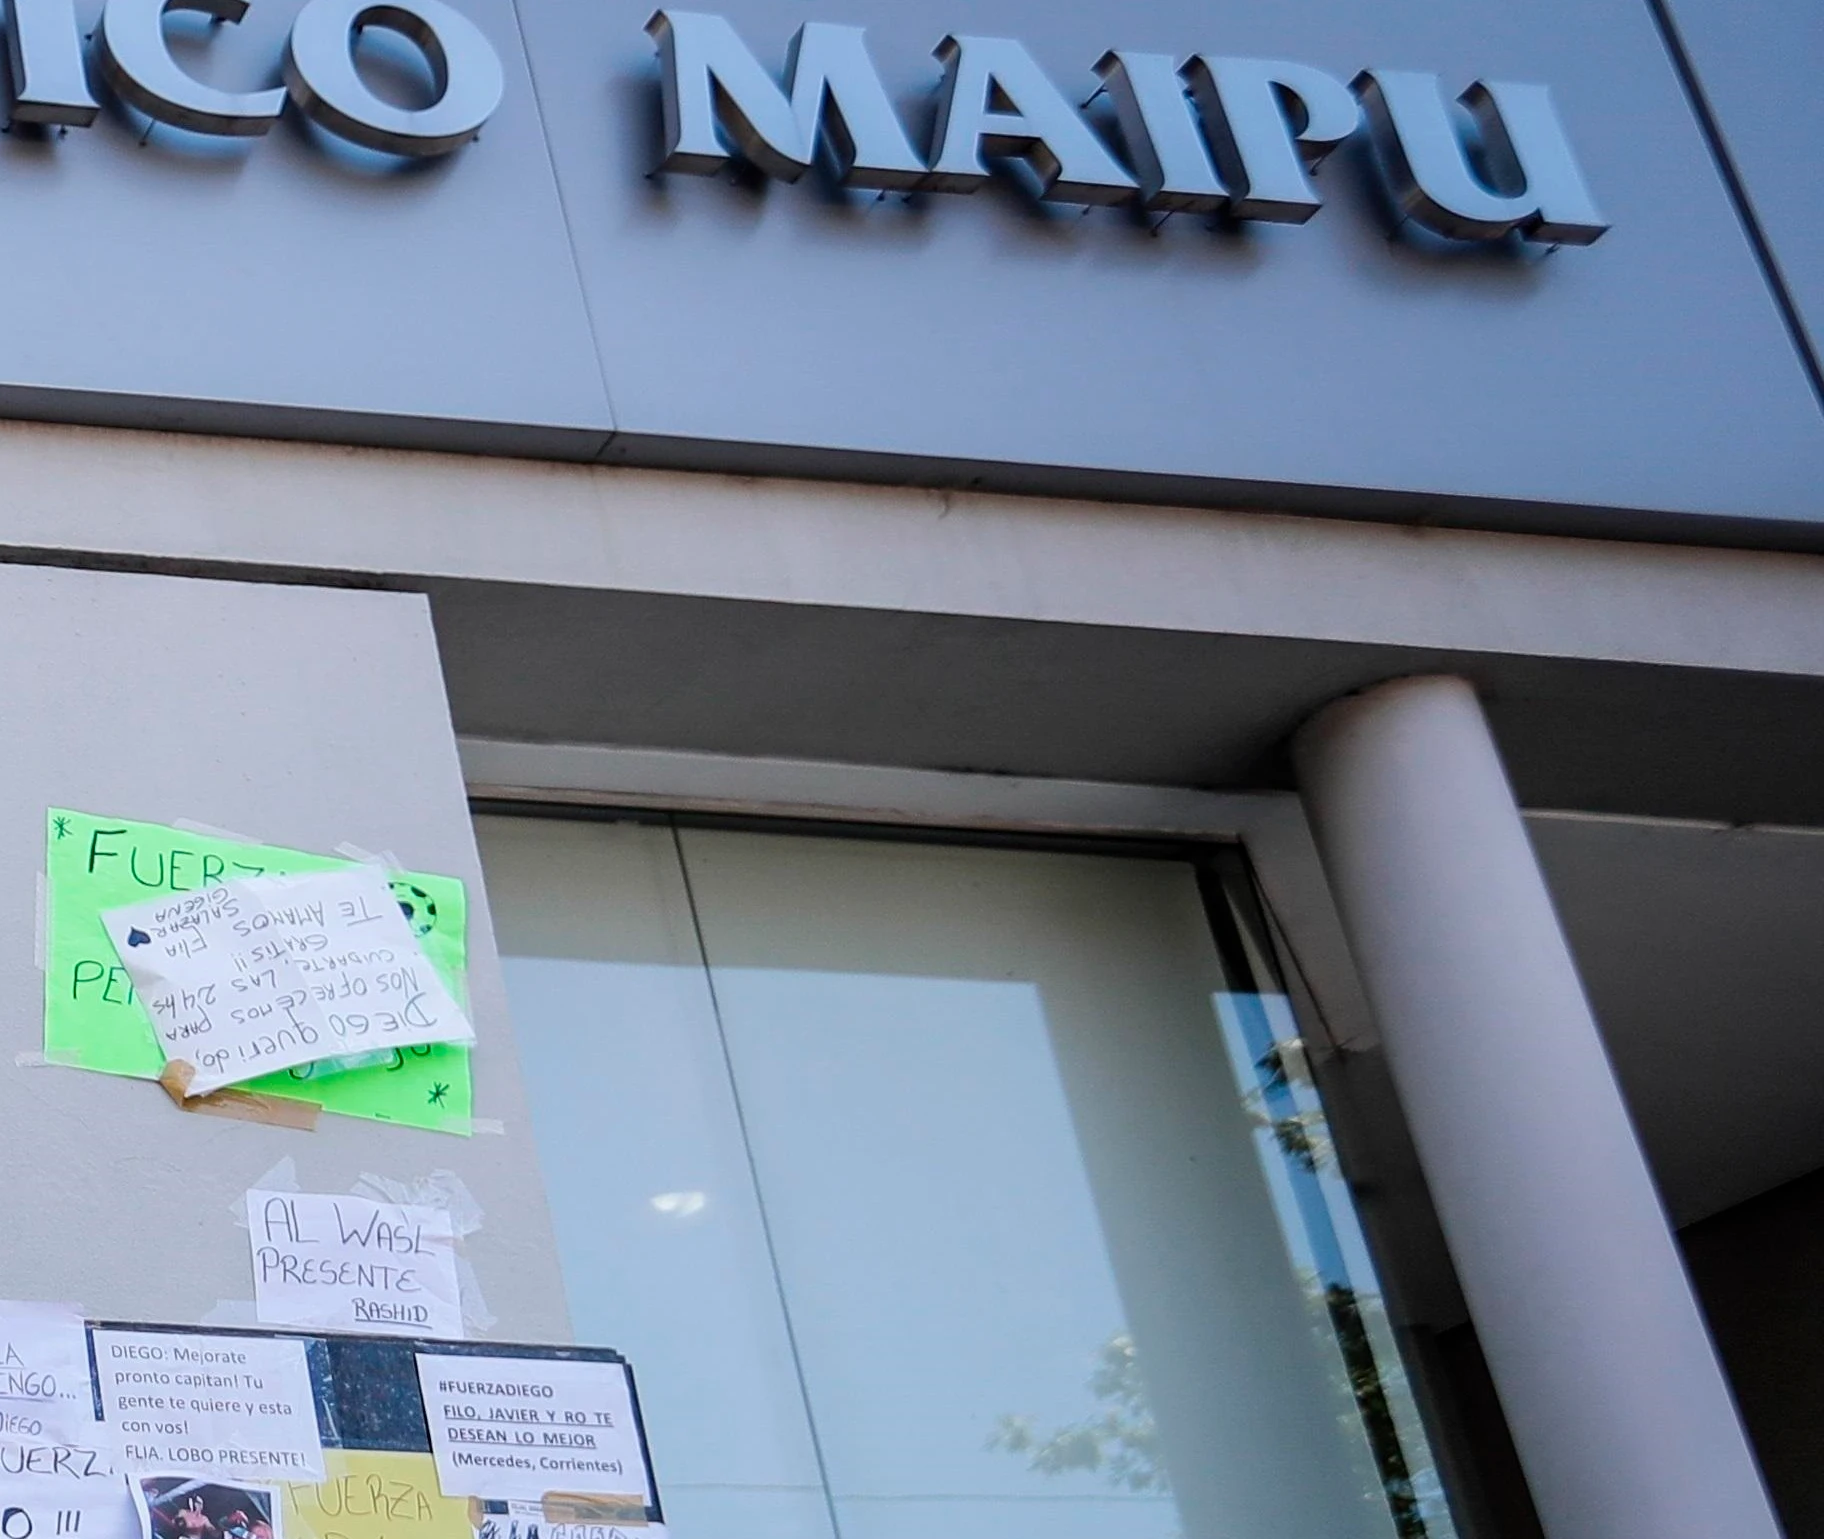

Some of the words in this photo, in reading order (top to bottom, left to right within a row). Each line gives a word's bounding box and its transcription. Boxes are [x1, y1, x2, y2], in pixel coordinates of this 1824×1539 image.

[643, 8, 1610, 246] MAIPU
[264, 1197, 319, 1245] AL
[258, 1246, 422, 1293] PRESENTE
[110, 1344, 169, 1361] DIEGO:
[173, 1347, 247, 1367] Mejorate
[115, 1371, 168, 1390] pronto
[243, 1374, 263, 1390] Tu
[438, 1380, 553, 1399] #FUERZADIEGO
[118, 1394, 165, 1415] gente
[169, 1397, 185, 1412] te
[190, 1397, 242, 1417] quiere
[246, 1402, 254, 1417] y
[259, 1402, 292, 1416] esta
[488, 1407, 539, 1423] JAVIER
[546, 1409, 557, 1423] Y
[564, 1410, 586, 1425] RO
[593, 1412, 613, 1426] TE
[121, 1421, 149, 1435] con
[153, 1420, 189, 1435] vos!
[447, 1427, 507, 1444] DESEAN
[514, 1430, 534, 1445] LO
[540, 1432, 595, 1448] MEJOR
[168, 1447, 216, 1464] LOBO
